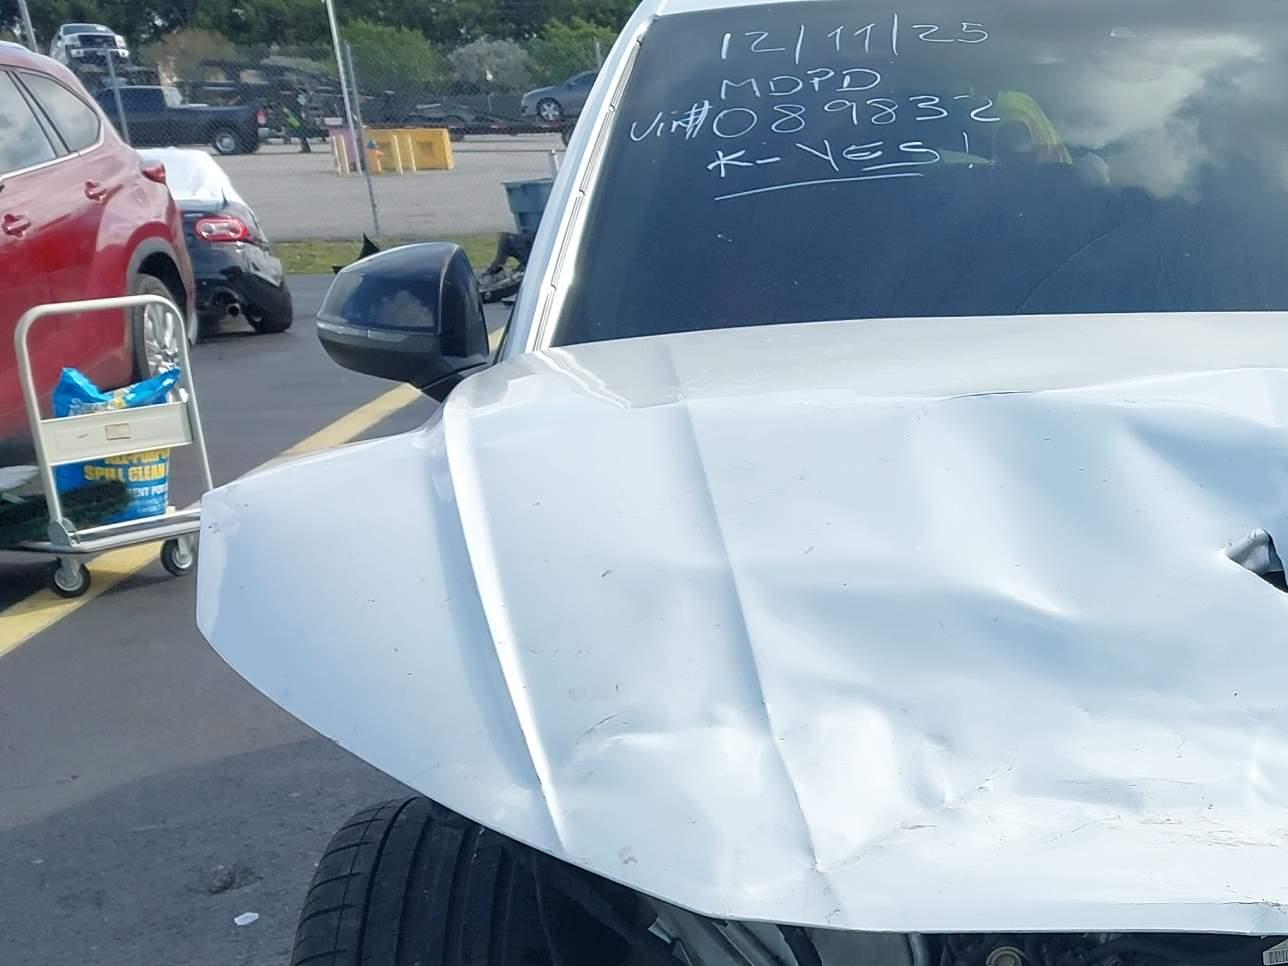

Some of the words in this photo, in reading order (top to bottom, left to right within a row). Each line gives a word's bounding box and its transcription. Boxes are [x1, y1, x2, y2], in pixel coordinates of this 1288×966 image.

[720, 13, 990, 64] 12/11/25
[720, 67, 881, 100] MDPD
[84, 465, 125, 481] SPILL
